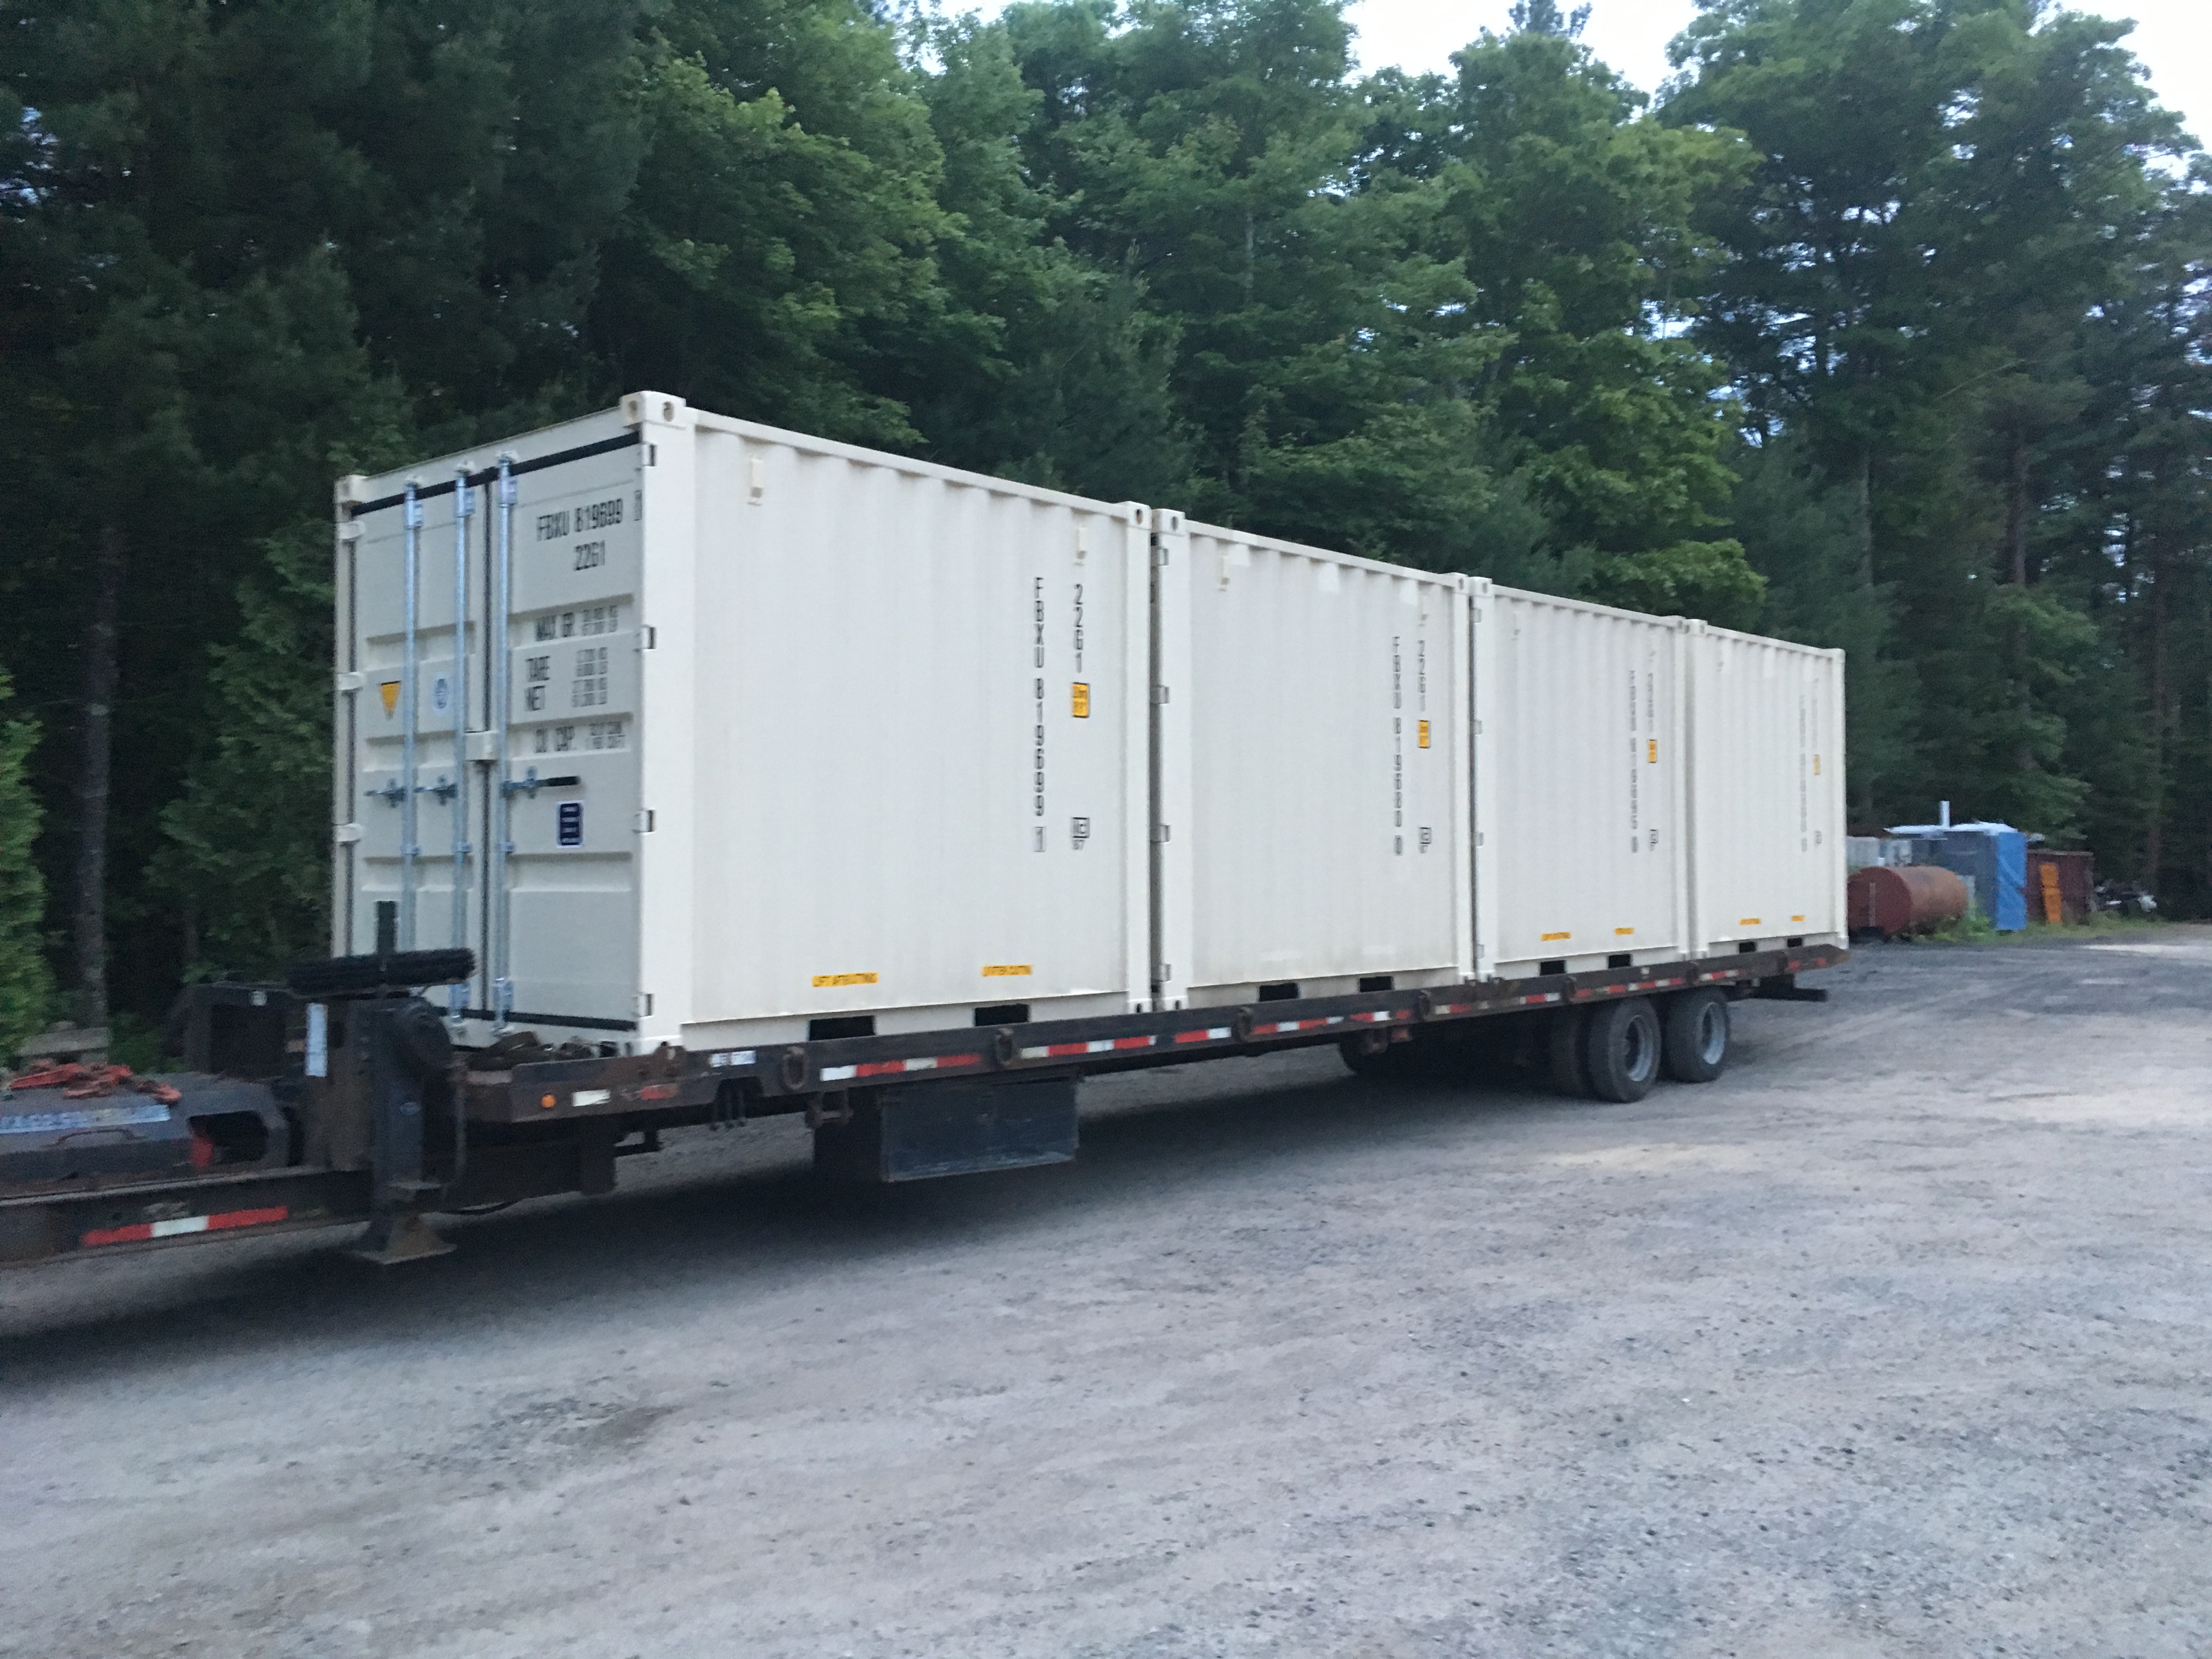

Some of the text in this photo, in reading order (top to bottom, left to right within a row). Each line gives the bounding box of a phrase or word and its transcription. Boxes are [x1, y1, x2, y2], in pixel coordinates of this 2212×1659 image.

[1034, 576, 1045, 668] FBXU
[1392, 636, 1402, 709] FBXU
[1034, 678, 1045, 816] 819699
